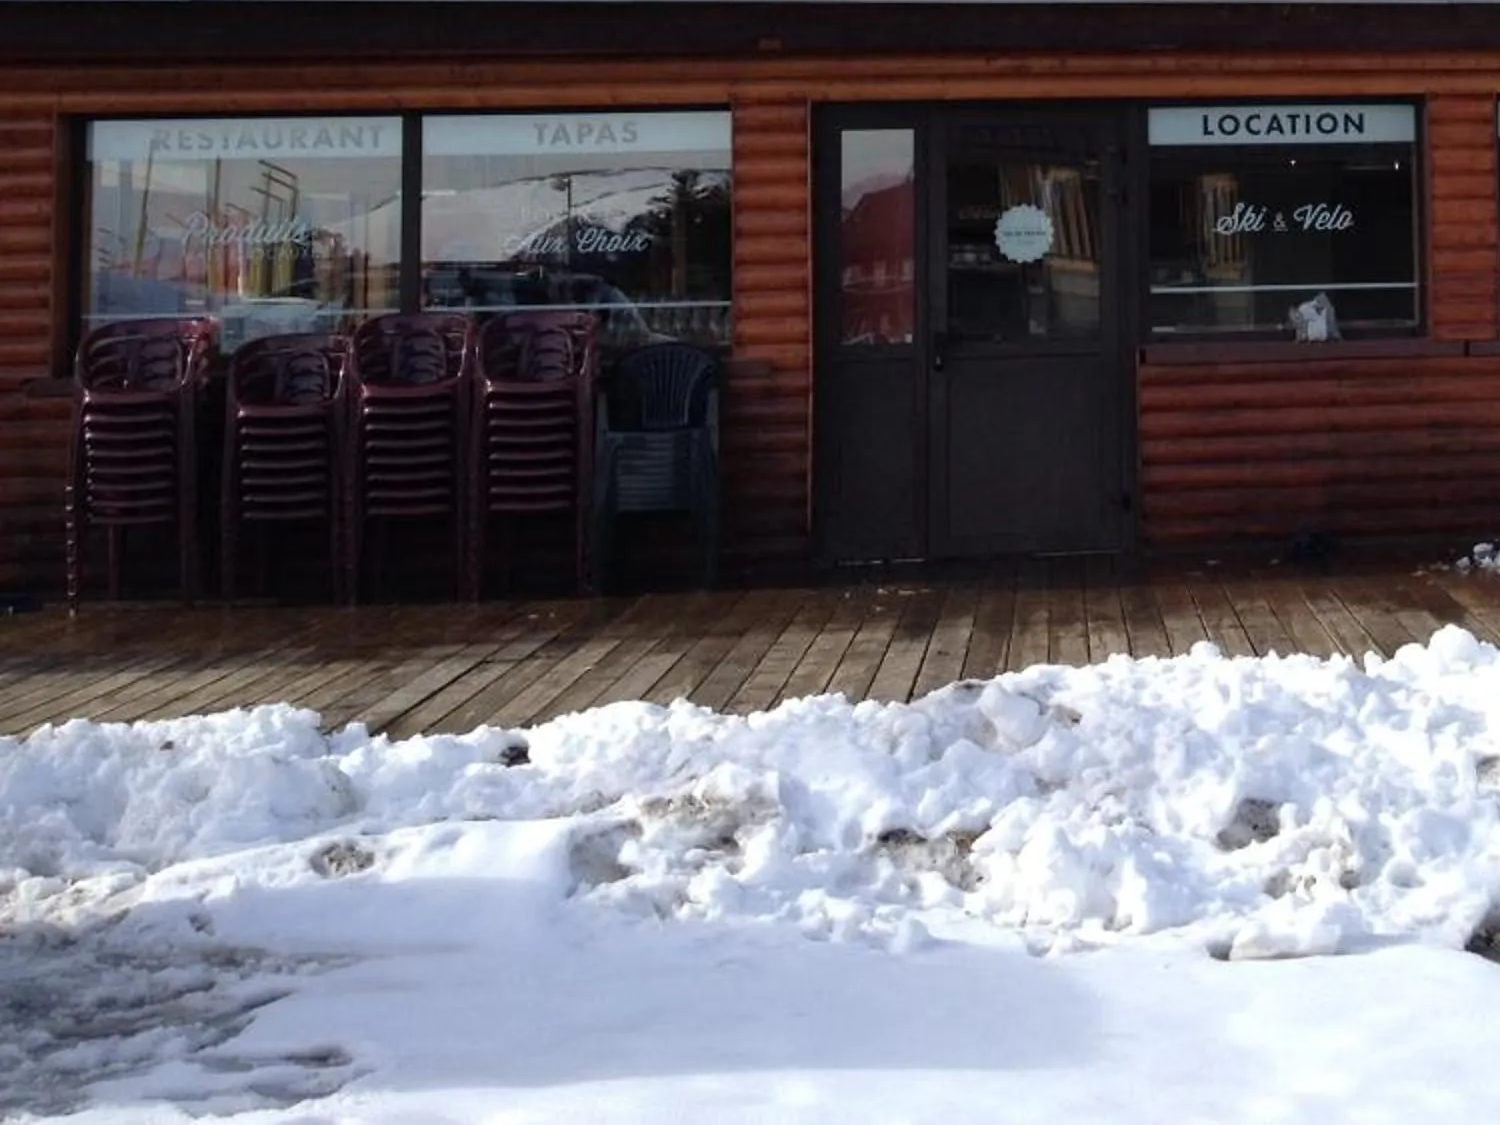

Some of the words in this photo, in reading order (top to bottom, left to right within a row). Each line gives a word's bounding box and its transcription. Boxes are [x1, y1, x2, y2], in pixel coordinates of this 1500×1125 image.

[533, 121, 639, 146] TAPAS
[1202, 112, 1366, 137] LOCATION
[151, 125, 385, 152] RESTAURANT
[1212, 202, 1267, 236] Ski
[1272, 211, 1289, 232] &
[575, 225, 655, 254] Choix
